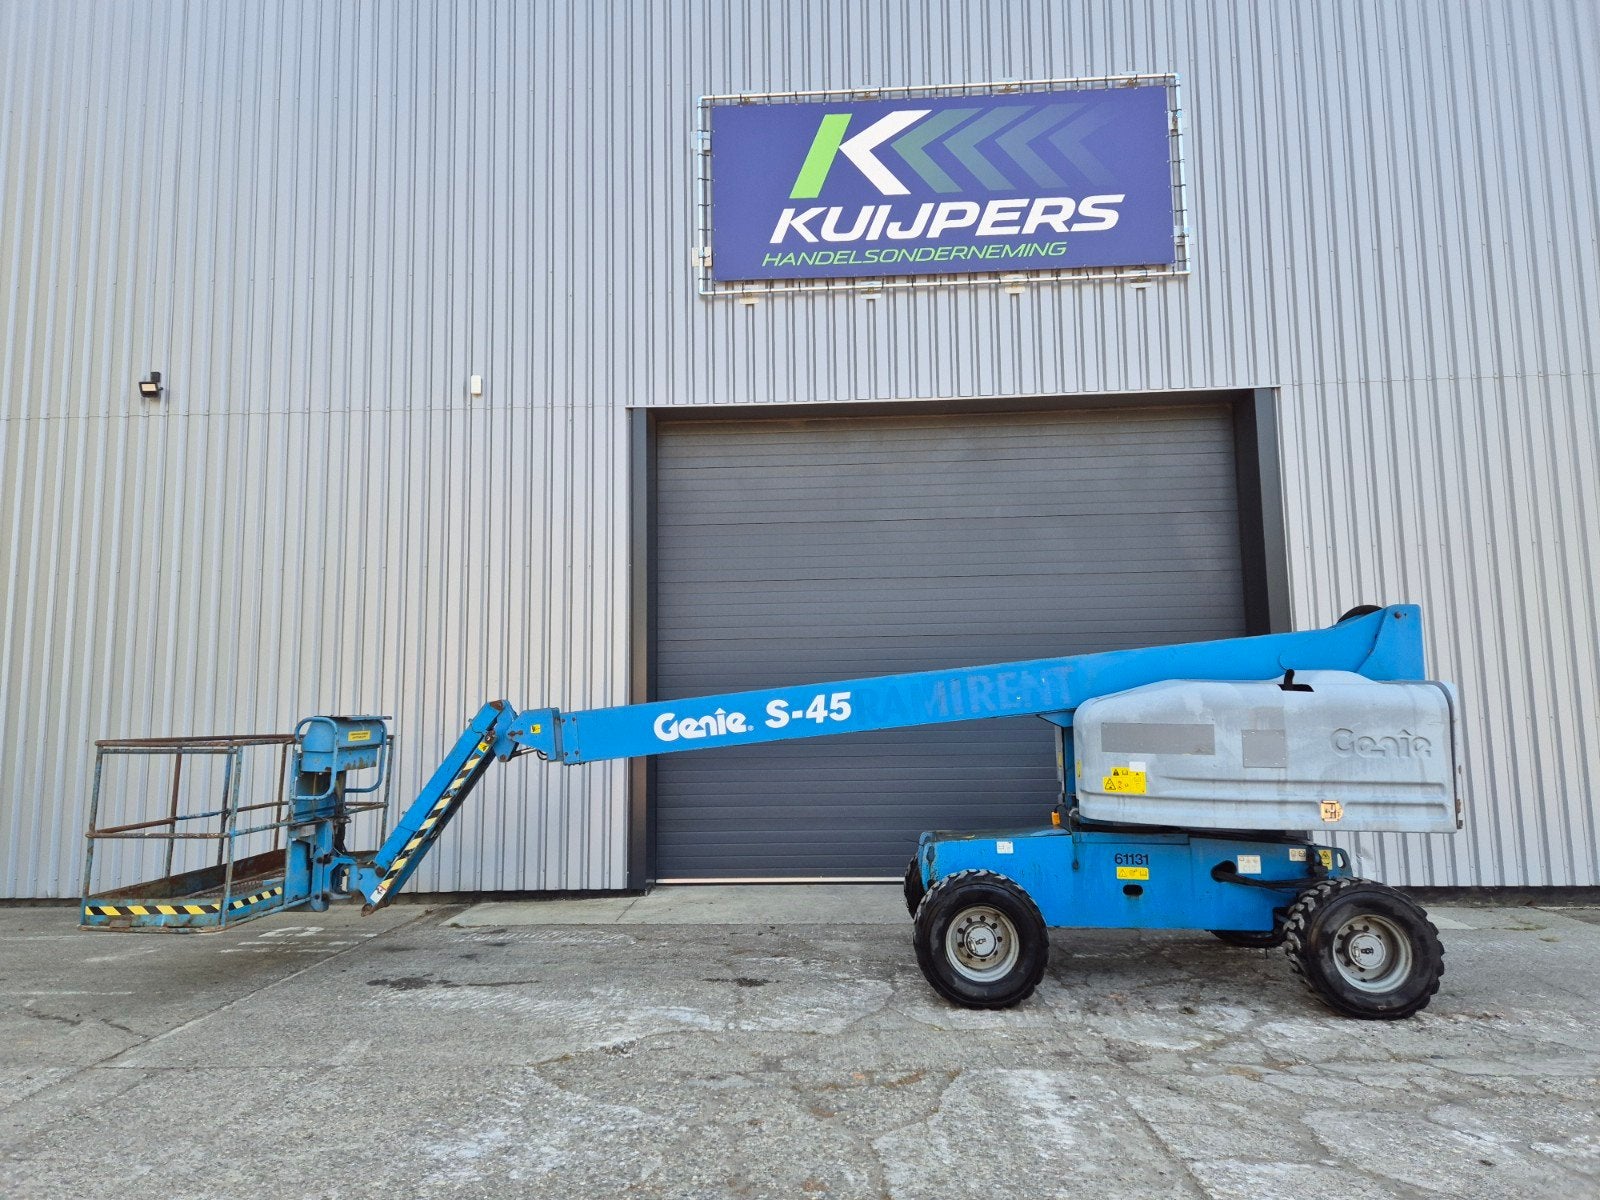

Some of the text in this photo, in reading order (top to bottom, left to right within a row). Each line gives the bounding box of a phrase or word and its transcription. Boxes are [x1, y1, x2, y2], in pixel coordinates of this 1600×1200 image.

[770, 195, 1124, 243] KUIJPERS
[762, 242, 1068, 267] HANDELSONDERNEMING
[654, 692, 851, 742] Genie S-45
[1331, 728, 1433, 758] Genie
[1114, 853, 1149, 865] 61131
